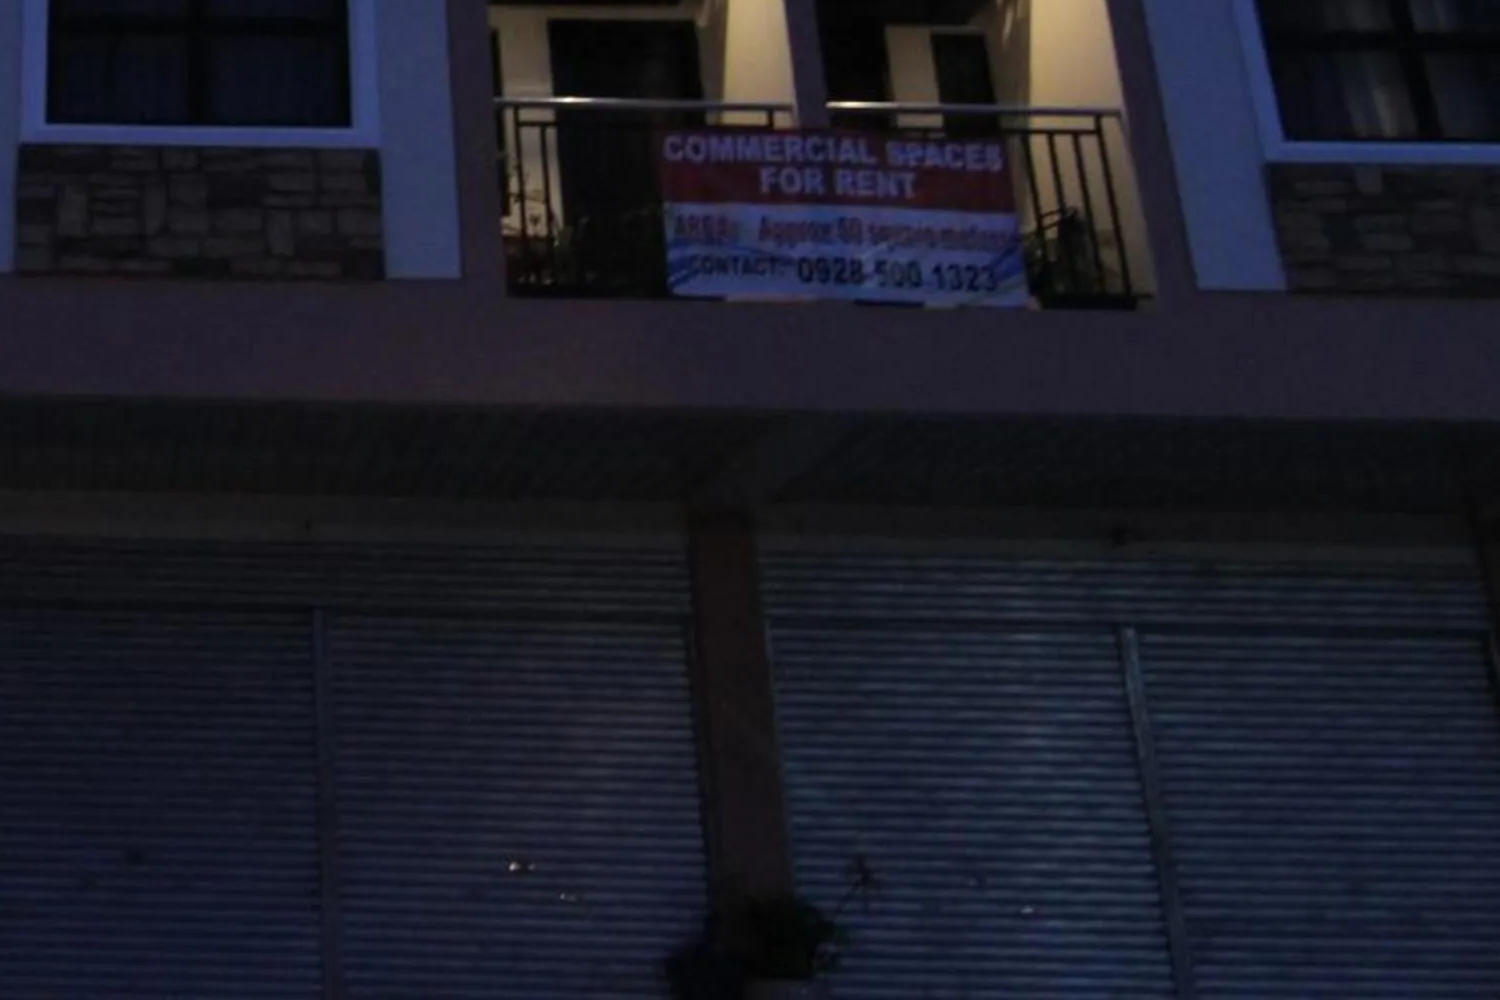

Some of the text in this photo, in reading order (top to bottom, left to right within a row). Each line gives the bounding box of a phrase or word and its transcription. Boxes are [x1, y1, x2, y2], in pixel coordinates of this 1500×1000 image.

[662, 135, 1004, 172] COMMERCIAL SPACES
[759, 168, 918, 198] FOR RENT
